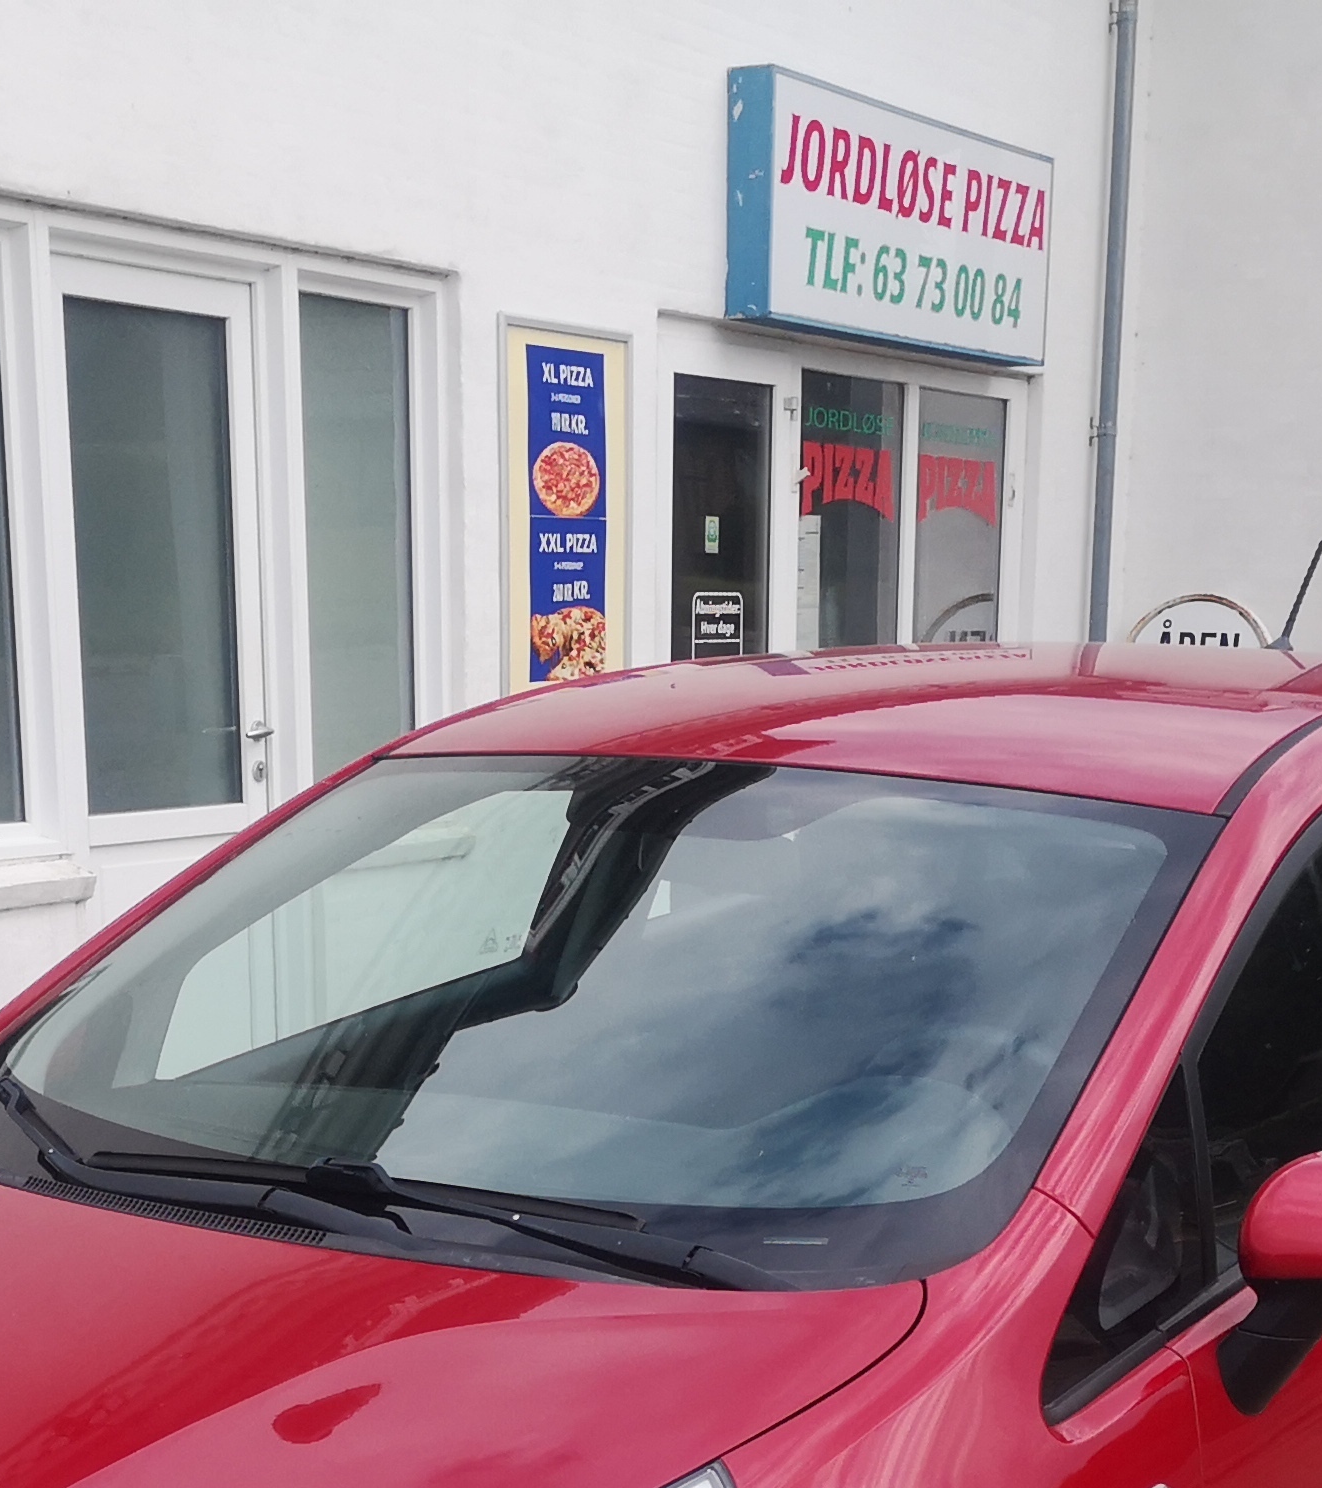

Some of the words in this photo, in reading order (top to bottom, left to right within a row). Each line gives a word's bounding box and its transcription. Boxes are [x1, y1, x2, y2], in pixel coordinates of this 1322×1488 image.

[780, 113, 957, 226] JORDLØSE
[962, 168, 1047, 251] PIZZA
[805, 226, 867, 296] TLF:
[873, 245, 907, 306] 63
[916, 254, 948, 312] 73
[954, 264, 986, 321] 00
[991, 273, 1023, 329] 84
[542, 362, 558, 384] XL
[559, 364, 594, 388] PIZZA
[804, 406, 895, 436] JORDLØSE
[801, 440, 895, 523] PIZZA
[917, 454, 998, 528] PIZZA
[539, 533, 564, 553] XXL
[566, 533, 597, 553] PIZZA
